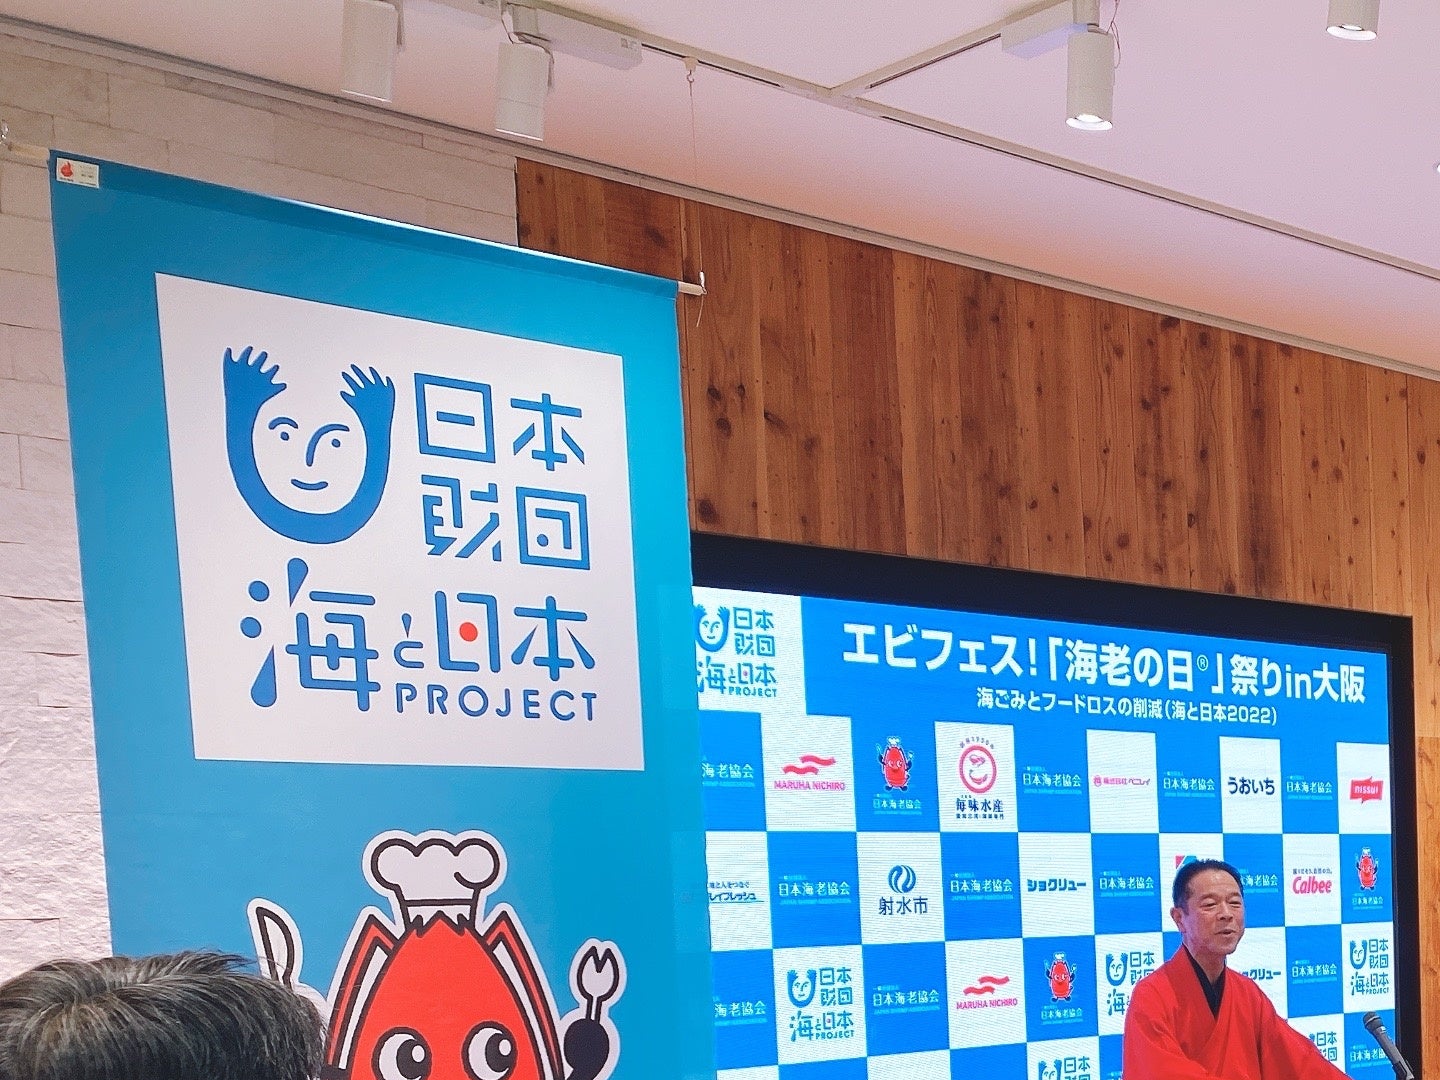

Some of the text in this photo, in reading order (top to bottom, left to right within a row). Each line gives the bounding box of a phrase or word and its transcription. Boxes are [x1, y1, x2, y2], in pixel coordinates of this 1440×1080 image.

[413, 372, 587, 472] 日本
[421, 473, 590, 571] 財団
[733, 606, 775, 631] 日本
[240, 557, 596, 712] 海と日本
[734, 631, 776, 657] 財団
[697, 655, 778, 695] 海と日本
[728, 686, 778, 698] PROJECT
[396, 682, 598, 721] PROJECT
[774, 780, 846, 792] MARUHA NICHIRO
[1022, 772, 1082, 788] 日本海老協会
[1163, 777, 1216, 791] 日本海老協会
[1228, 776, 1276, 796] うおいち
[1286, 781, 1333, 794] 日本海老協会
[872, 798, 922, 810] 日本海老協会
[778, 881, 851, 897] 日本海老協会
[950, 878, 1013, 893] 日本海老協会
[1026, 878, 1087, 893] ショクリュー
[1099, 876, 1154, 891] 日本海老協会
[1292, 875, 1333, 895] Calbee
[878, 895, 929, 916] 射水市
[1351, 896, 1384, 906] 日本海老協会
[1368, 938, 1389, 953] 日本
[1129, 951, 1155, 967] 日本
[1369, 953, 1389, 969] 財団
[819, 966, 853, 986] 日本
[1291, 963, 1338, 978] 日本海老協会
[1350, 971, 1390, 996] 海と日本
[1365, 987, 1390, 996] PROJECT
[820, 986, 854, 1006] 財団
[872, 988, 940, 1007] 日本海老協会
[956, 997, 1019, 1010] MARUHA NICHIRO
[1040, 1007, 1083, 1020] 日本海老協会
[788, 1009, 855, 1043] 海と日本
[815, 1029, 855, 1040] PROJECT
[1316, 1031, 1337, 1047] 日本
[1349, 1047, 1389, 1063] 日本海老協
[1062, 1055, 1092, 1074] 日本
